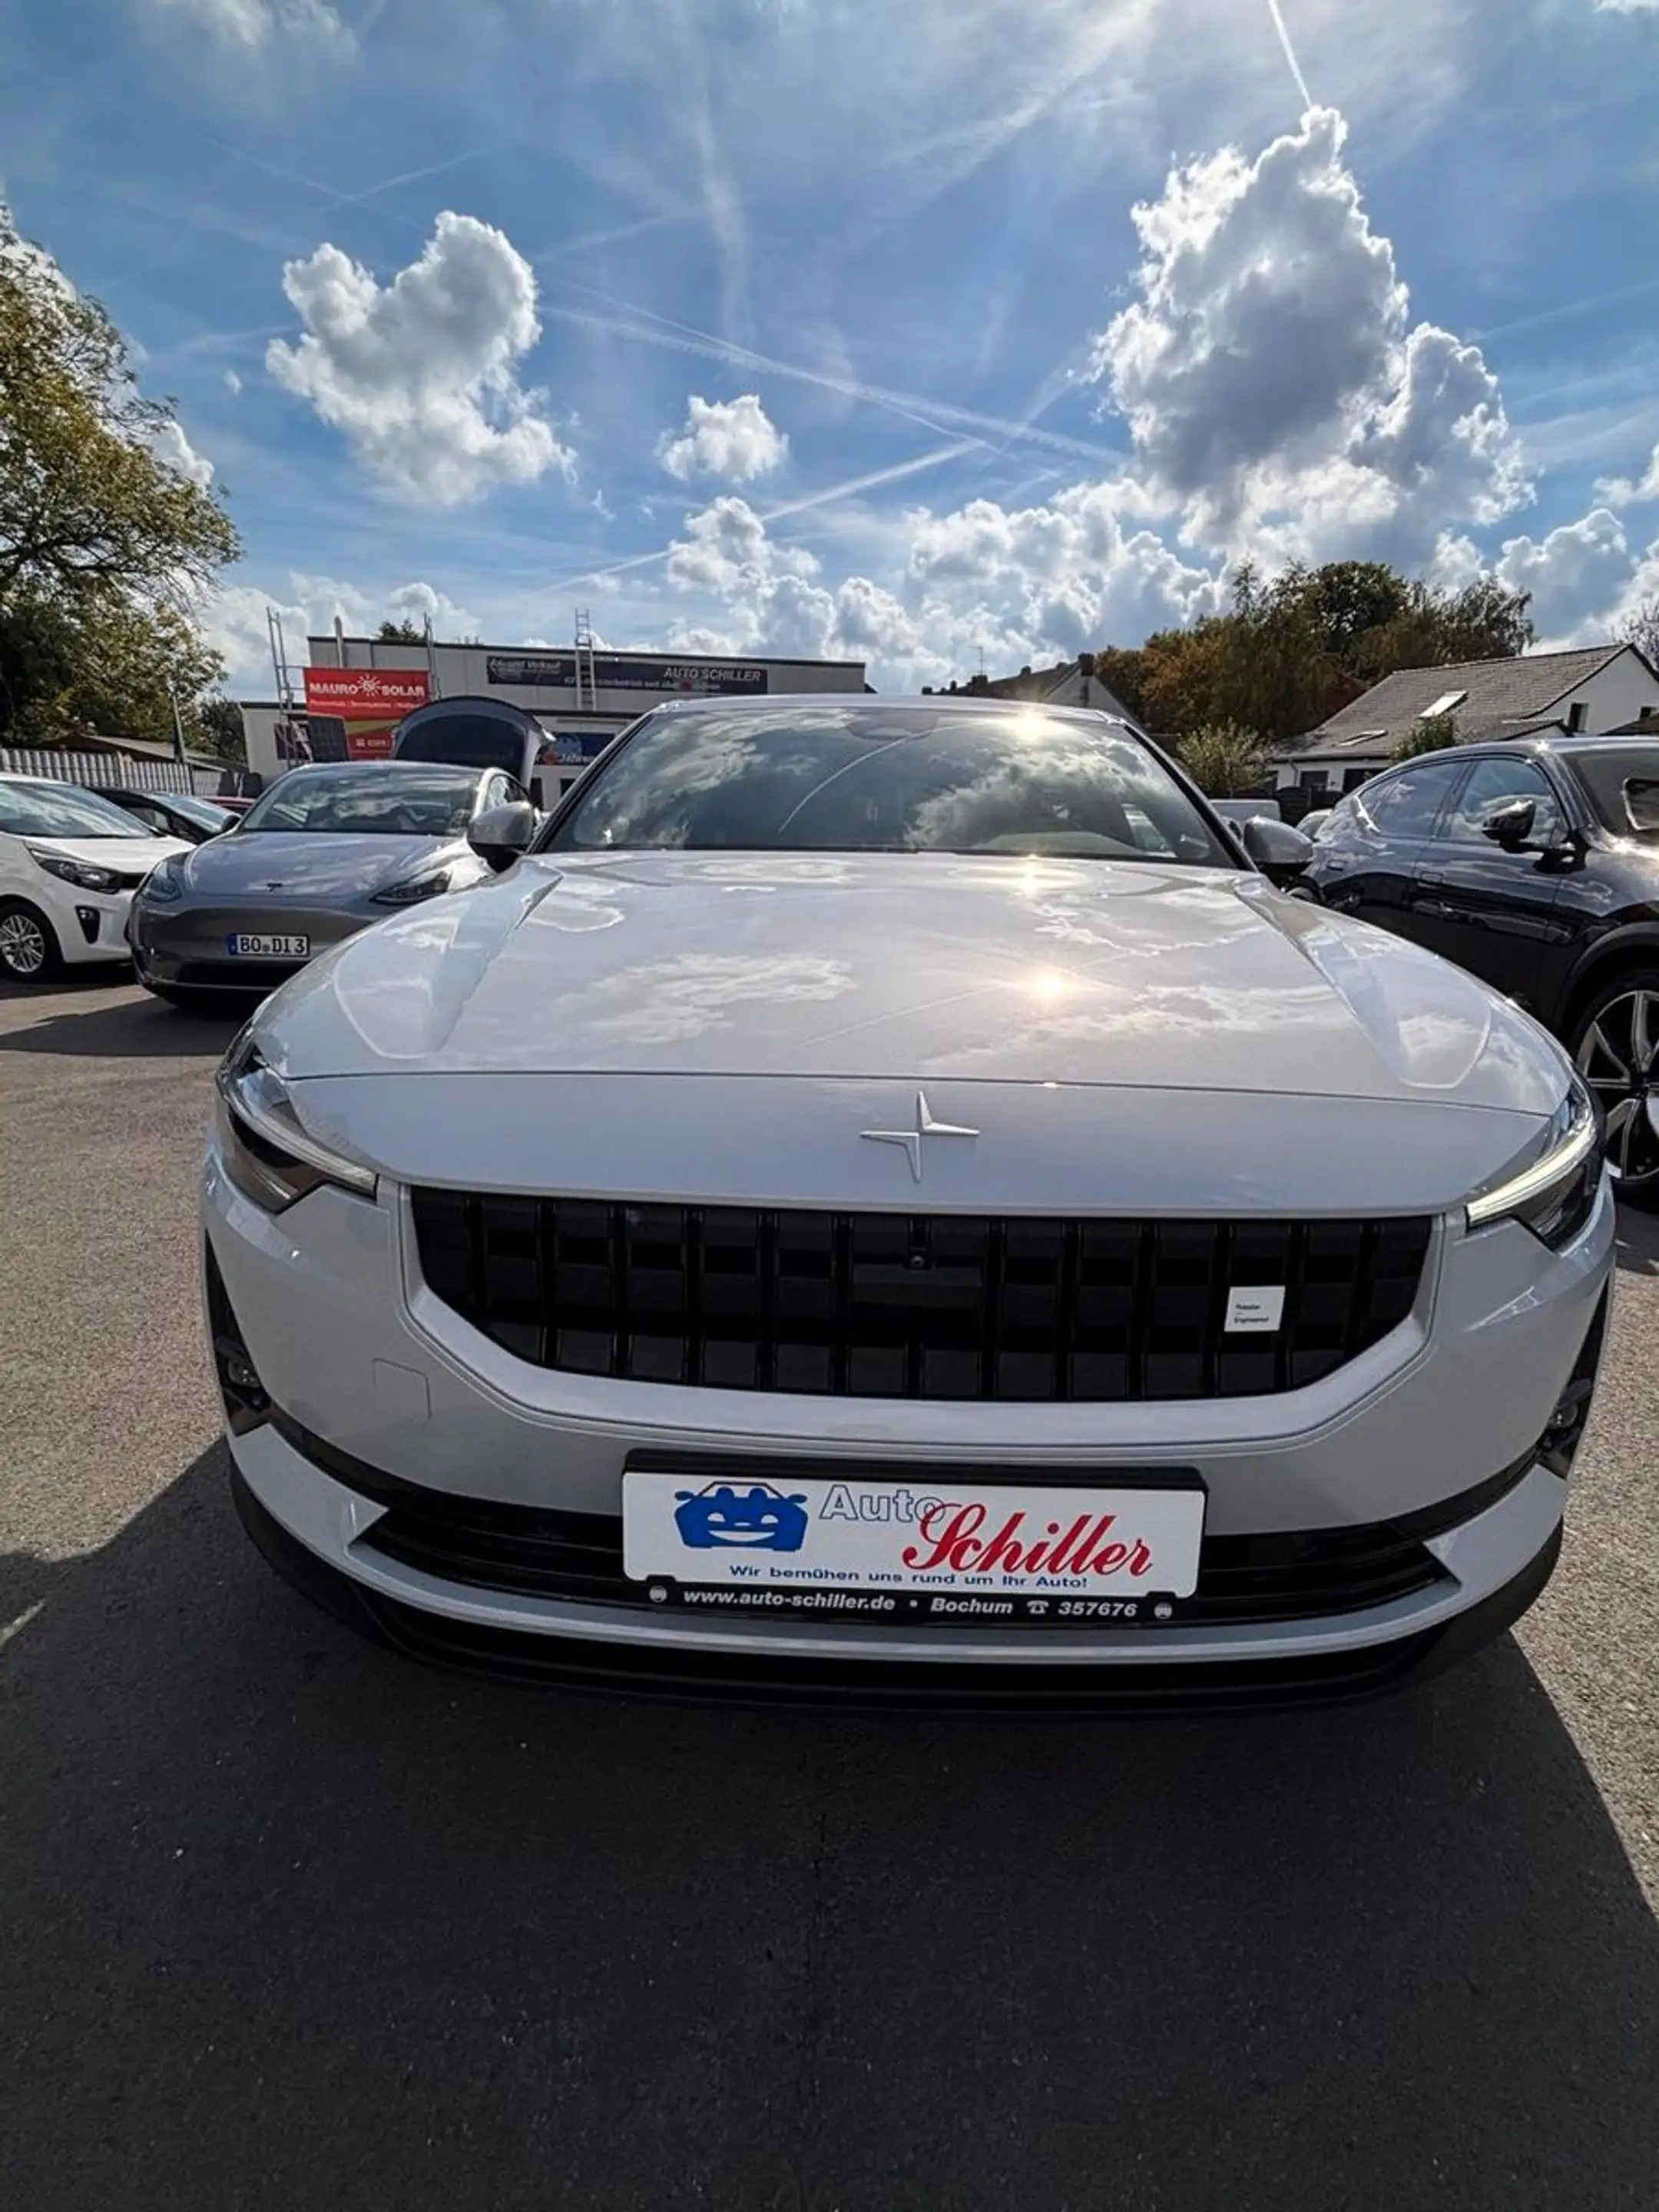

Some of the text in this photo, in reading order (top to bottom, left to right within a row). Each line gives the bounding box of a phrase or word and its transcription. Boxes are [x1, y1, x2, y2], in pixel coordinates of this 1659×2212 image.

[664, 667, 761, 682] AUTO SCHILLER
[310, 683, 425, 697] MAURO SOLAR
[240, 937, 305, 954] BO DI 3
[819, 1484, 1154, 1578] Auto Schiller
[730, 1564, 1088, 1589] Wir bemühen uns rund um Ihr Auto!
[683, 1589, 1139, 1618] www.auto-schiller.de Bochum 357676
